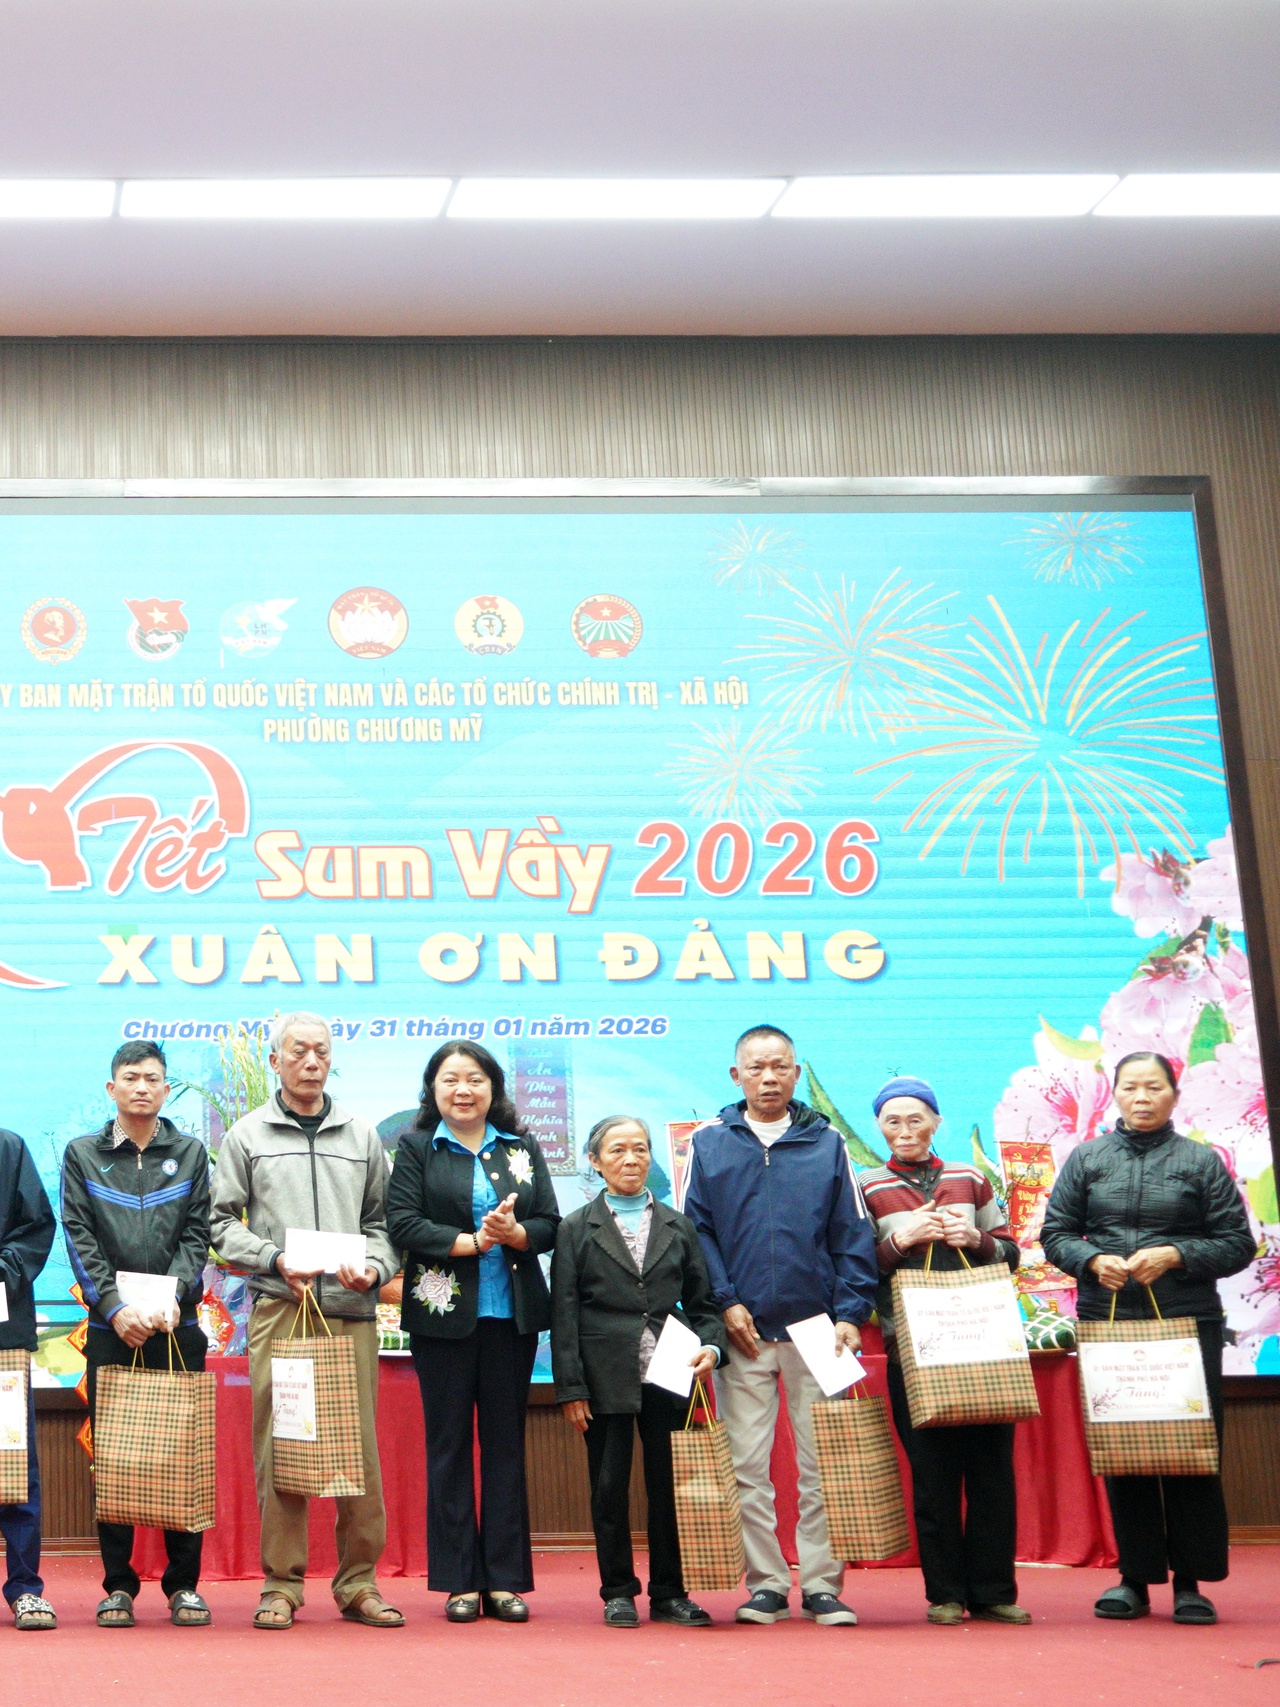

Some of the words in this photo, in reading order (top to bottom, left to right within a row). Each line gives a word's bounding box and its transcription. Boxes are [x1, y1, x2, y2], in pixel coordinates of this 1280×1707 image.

[19, 683, 61, 707] BAN
[68, 678, 114, 712] MẶT
[121, 678, 174, 712] TRẬN
[181, 677, 207, 707] TỔ
[212, 678, 268, 710] QUỐC
[275, 678, 317, 712] VIỆT
[325, 683, 373, 707] NAM
[380, 678, 408, 706] VÀ
[415, 678, 455, 706] CÁC
[461, 676, 488, 706] TỔ
[494, 677, 551, 706] CHỨC
[557, 677, 619, 705] CHÍNH
[625, 682, 658, 710] TRỊ
[680, 676, 708, 705] XÃ
[714, 676, 749, 709] HỘI
[263, 713, 349, 743] PHƯỜNG
[356, 716, 442, 742] CHƯƠNG
[449, 712, 483, 742] MỸ
[76, 796, 227, 893] Tết
[255, 829, 433, 899] Sum
[446, 815, 612, 914] Vầy
[633, 819, 879, 896] 2026
[97, 924, 375, 985] XUÂN
[418, 932, 560, 983] ƠN
[598, 919, 886, 982] ĐẢNG
[123, 1020, 232, 1042] Chương
[331, 1018, 361, 1040] ày
[369, 1019, 396, 1037] 31
[405, 1017, 485, 1041] tháng
[493, 1018, 521, 1037] 01
[530, 1016, 590, 1036] năm
[598, 1017, 668, 1036] 2026
